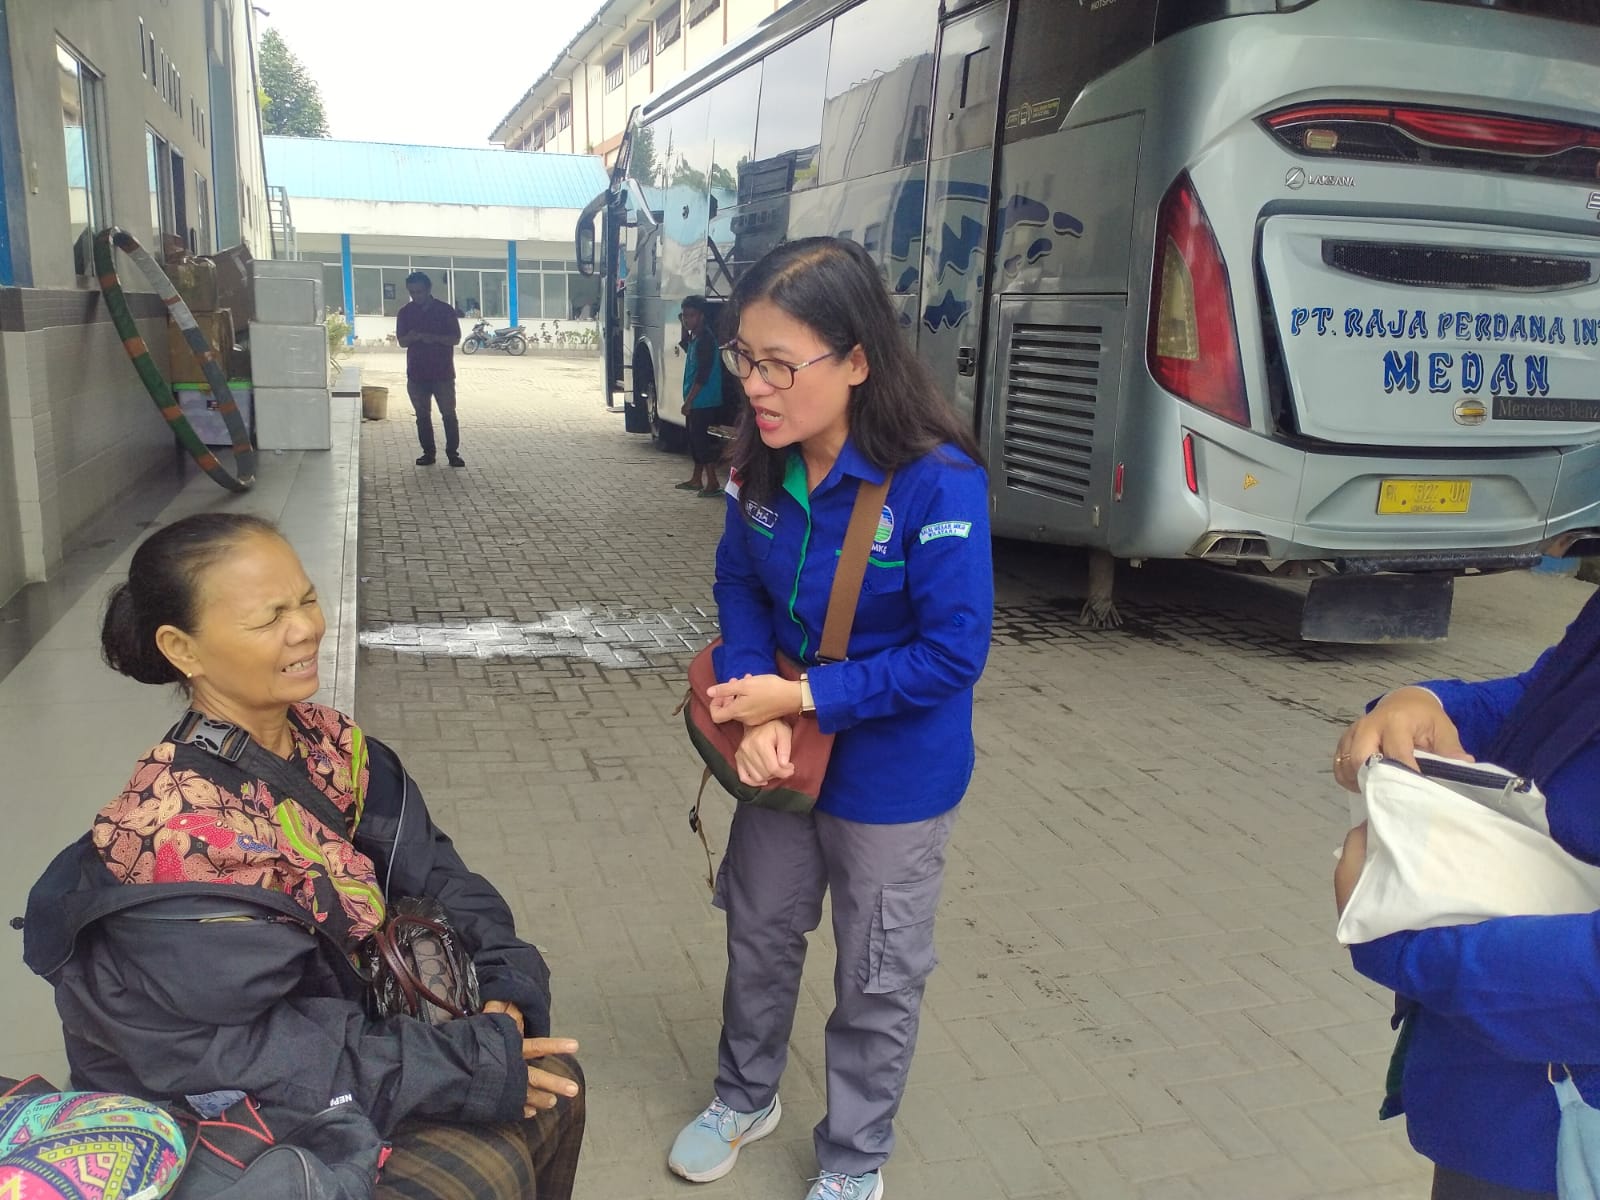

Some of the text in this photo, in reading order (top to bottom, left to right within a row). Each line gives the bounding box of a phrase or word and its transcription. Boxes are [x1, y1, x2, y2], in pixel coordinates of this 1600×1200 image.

[1308, 175, 1356, 187] LAKSANA
[1291, 307, 1600, 345] PT. RAJA PERDANA IN
[1382, 350, 1550, 396] MEDAN
[871, 543, 888, 555] MKG
